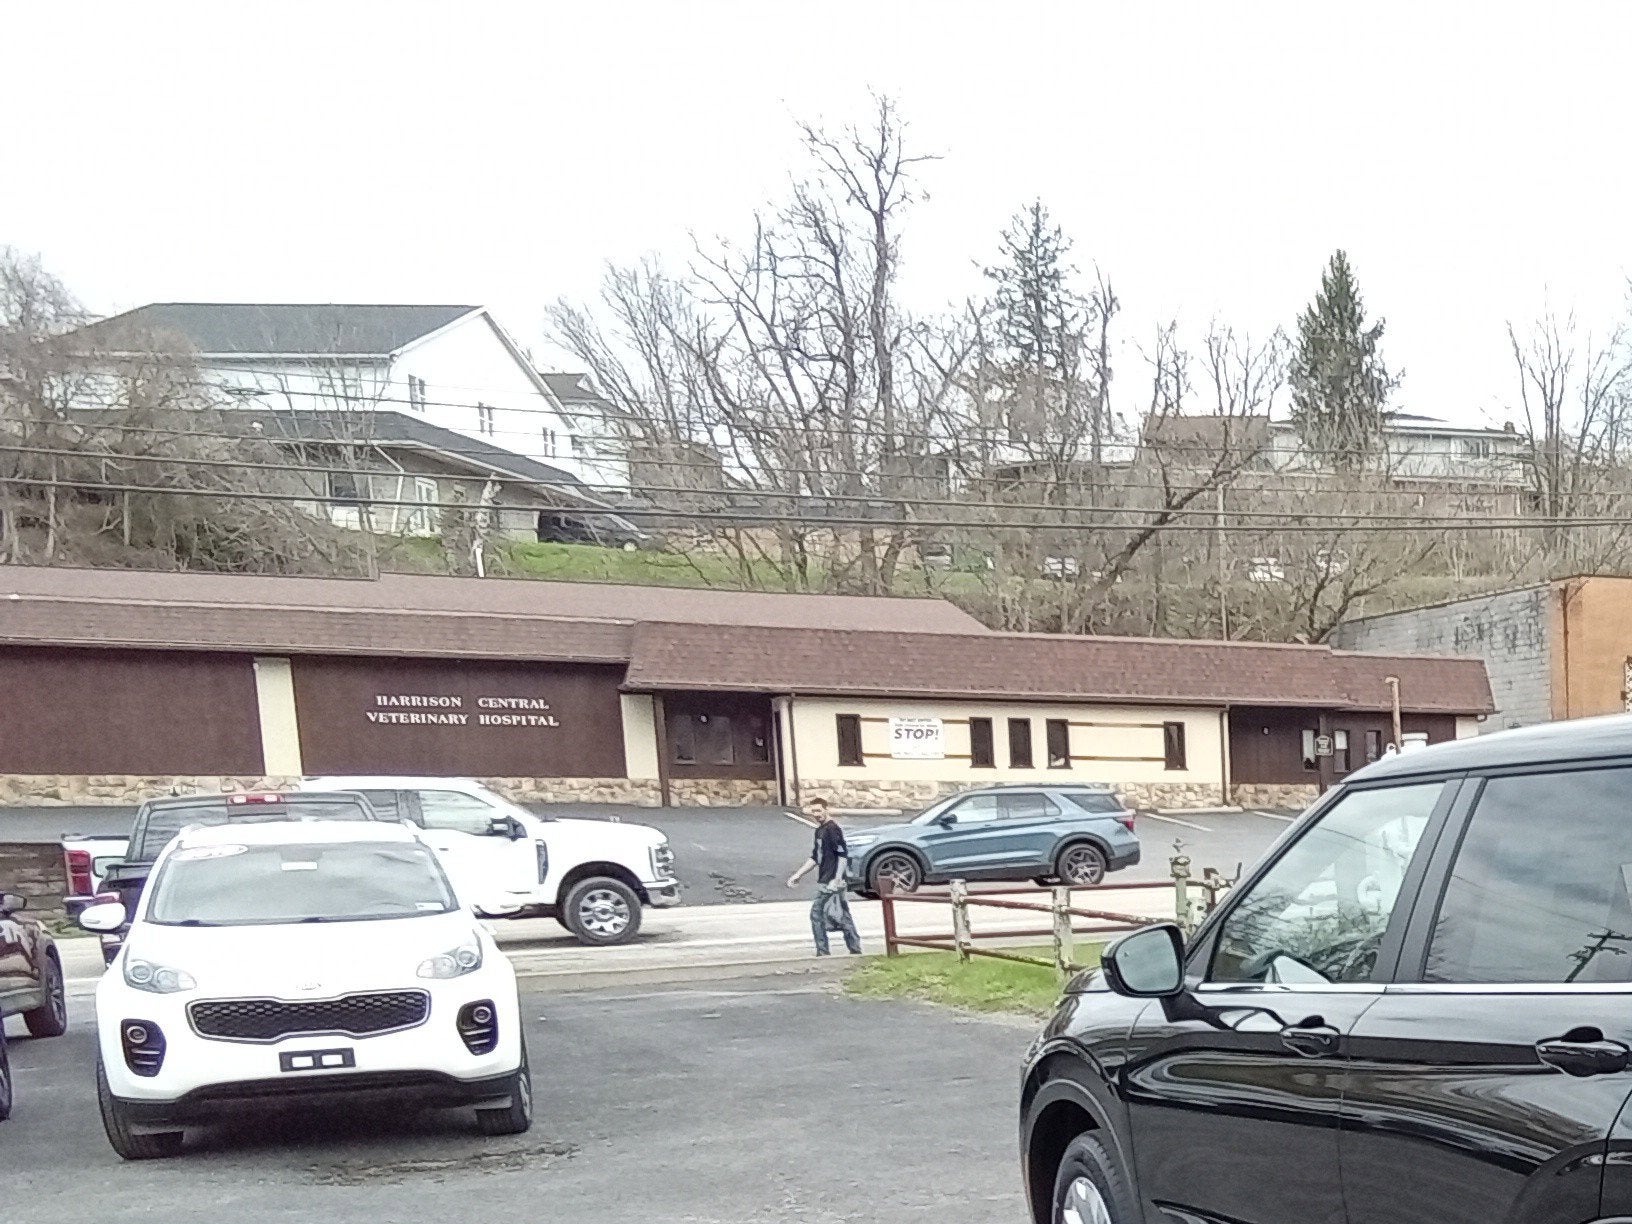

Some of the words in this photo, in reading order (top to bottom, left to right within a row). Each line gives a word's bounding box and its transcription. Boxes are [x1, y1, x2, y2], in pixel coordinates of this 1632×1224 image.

[376, 695, 462, 707] HARRISON
[477, 697, 549, 709] CENTRAL
[365, 711, 469, 725] VETERINARY
[478, 714, 560, 727] HOSPITAL
[894, 728, 939, 740] STOP!
